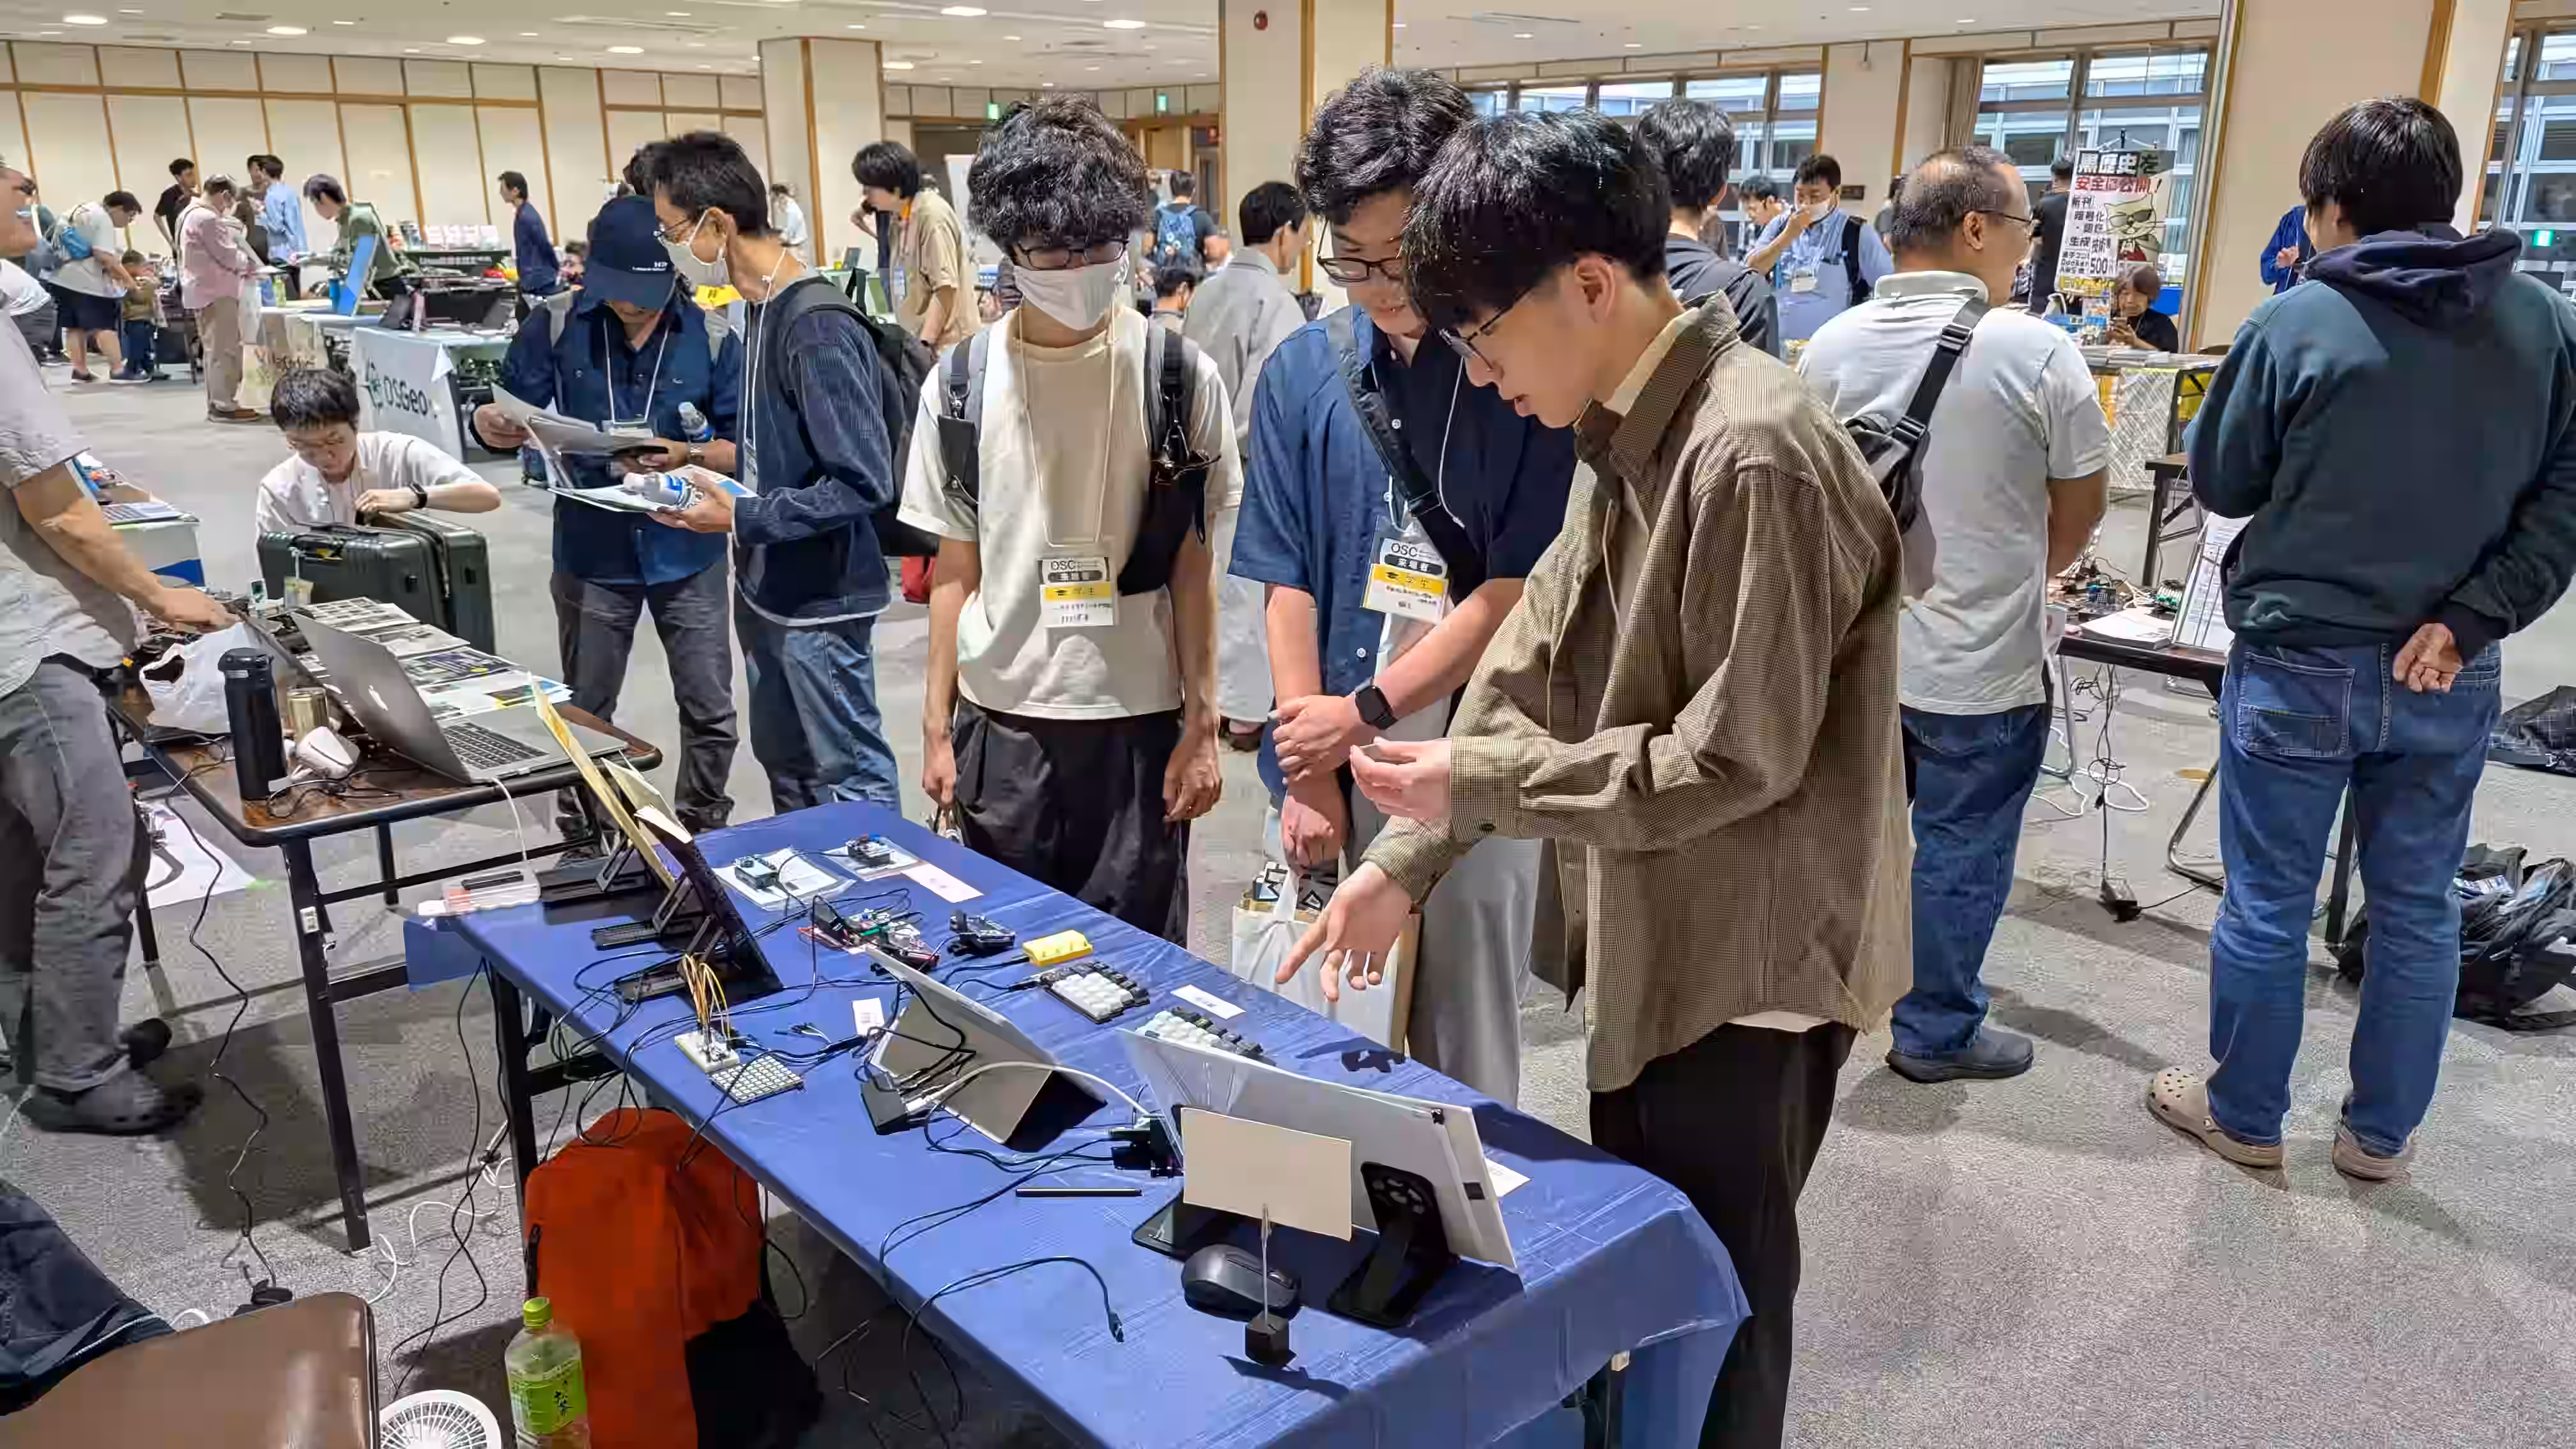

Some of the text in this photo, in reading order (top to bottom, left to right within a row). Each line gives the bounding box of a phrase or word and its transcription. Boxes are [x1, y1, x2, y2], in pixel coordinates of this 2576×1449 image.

[383, 374, 429, 417] OSGeo
[1391, 542, 1417, 558] OSC
[1050, 560, 1075, 571] OSC
